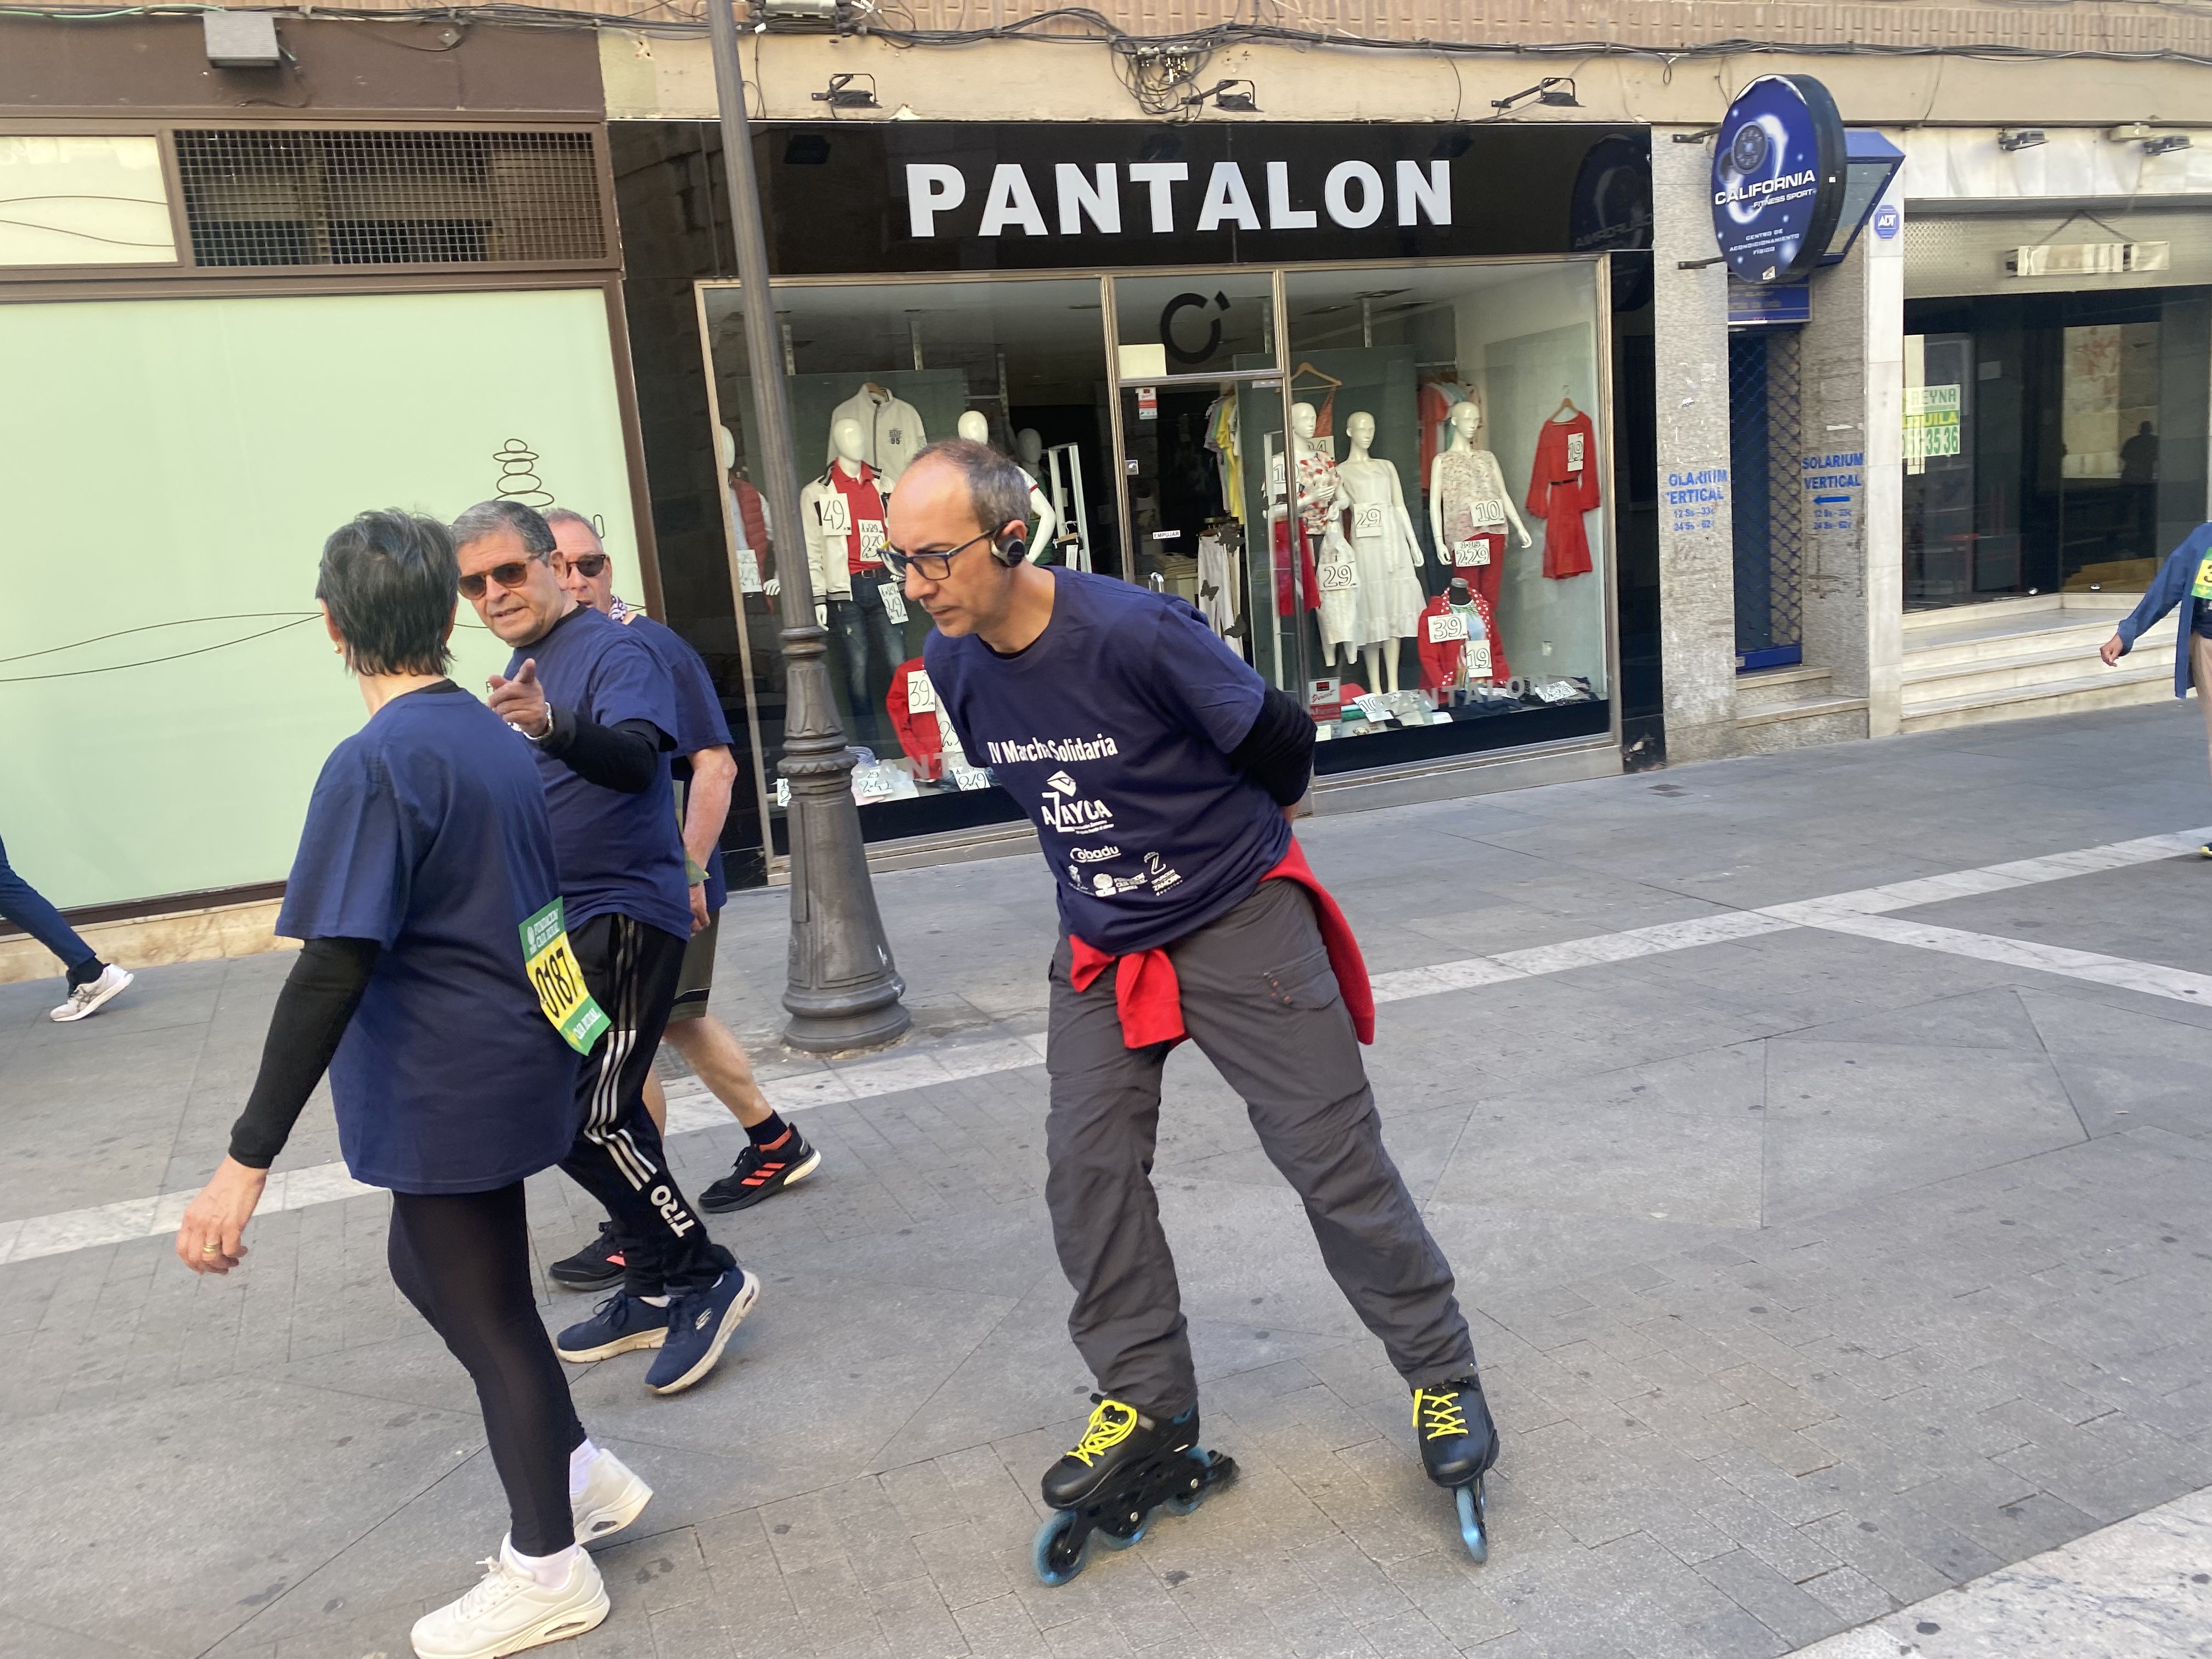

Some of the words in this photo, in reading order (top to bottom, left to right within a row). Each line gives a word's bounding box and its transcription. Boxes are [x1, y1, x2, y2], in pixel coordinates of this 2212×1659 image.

[1714, 170, 1816, 205] CALIFORNIA
[906, 159, 1452, 238] PANTALON
[1753, 194, 1785, 208] FITNESS
[1878, 215, 1897, 227] ADT
[1746, 231, 1772, 241] CENTRO
[1568, 441, 1583, 462] 19
[1802, 453, 1864, 470] SOLARIUM
[1803, 473, 1861, 489] VERTICAL
[1665, 487, 1724, 504] ERTICAL
[1356, 508, 1381, 528] 29
[1476, 500, 1500, 522] 10
[1323, 565, 1352, 588] 29
[1434, 616, 1462, 640] 39
[1466, 648, 1490, 669] 19
[908, 680, 930, 706] 39
[988, 742, 1002, 764] IV
[1047, 733, 1118, 762] Solidaria
[1041, 791, 1113, 833] AZAYCA
[1070, 845, 1121, 863] Cobadu
[535, 946, 578, 1019] 0187
